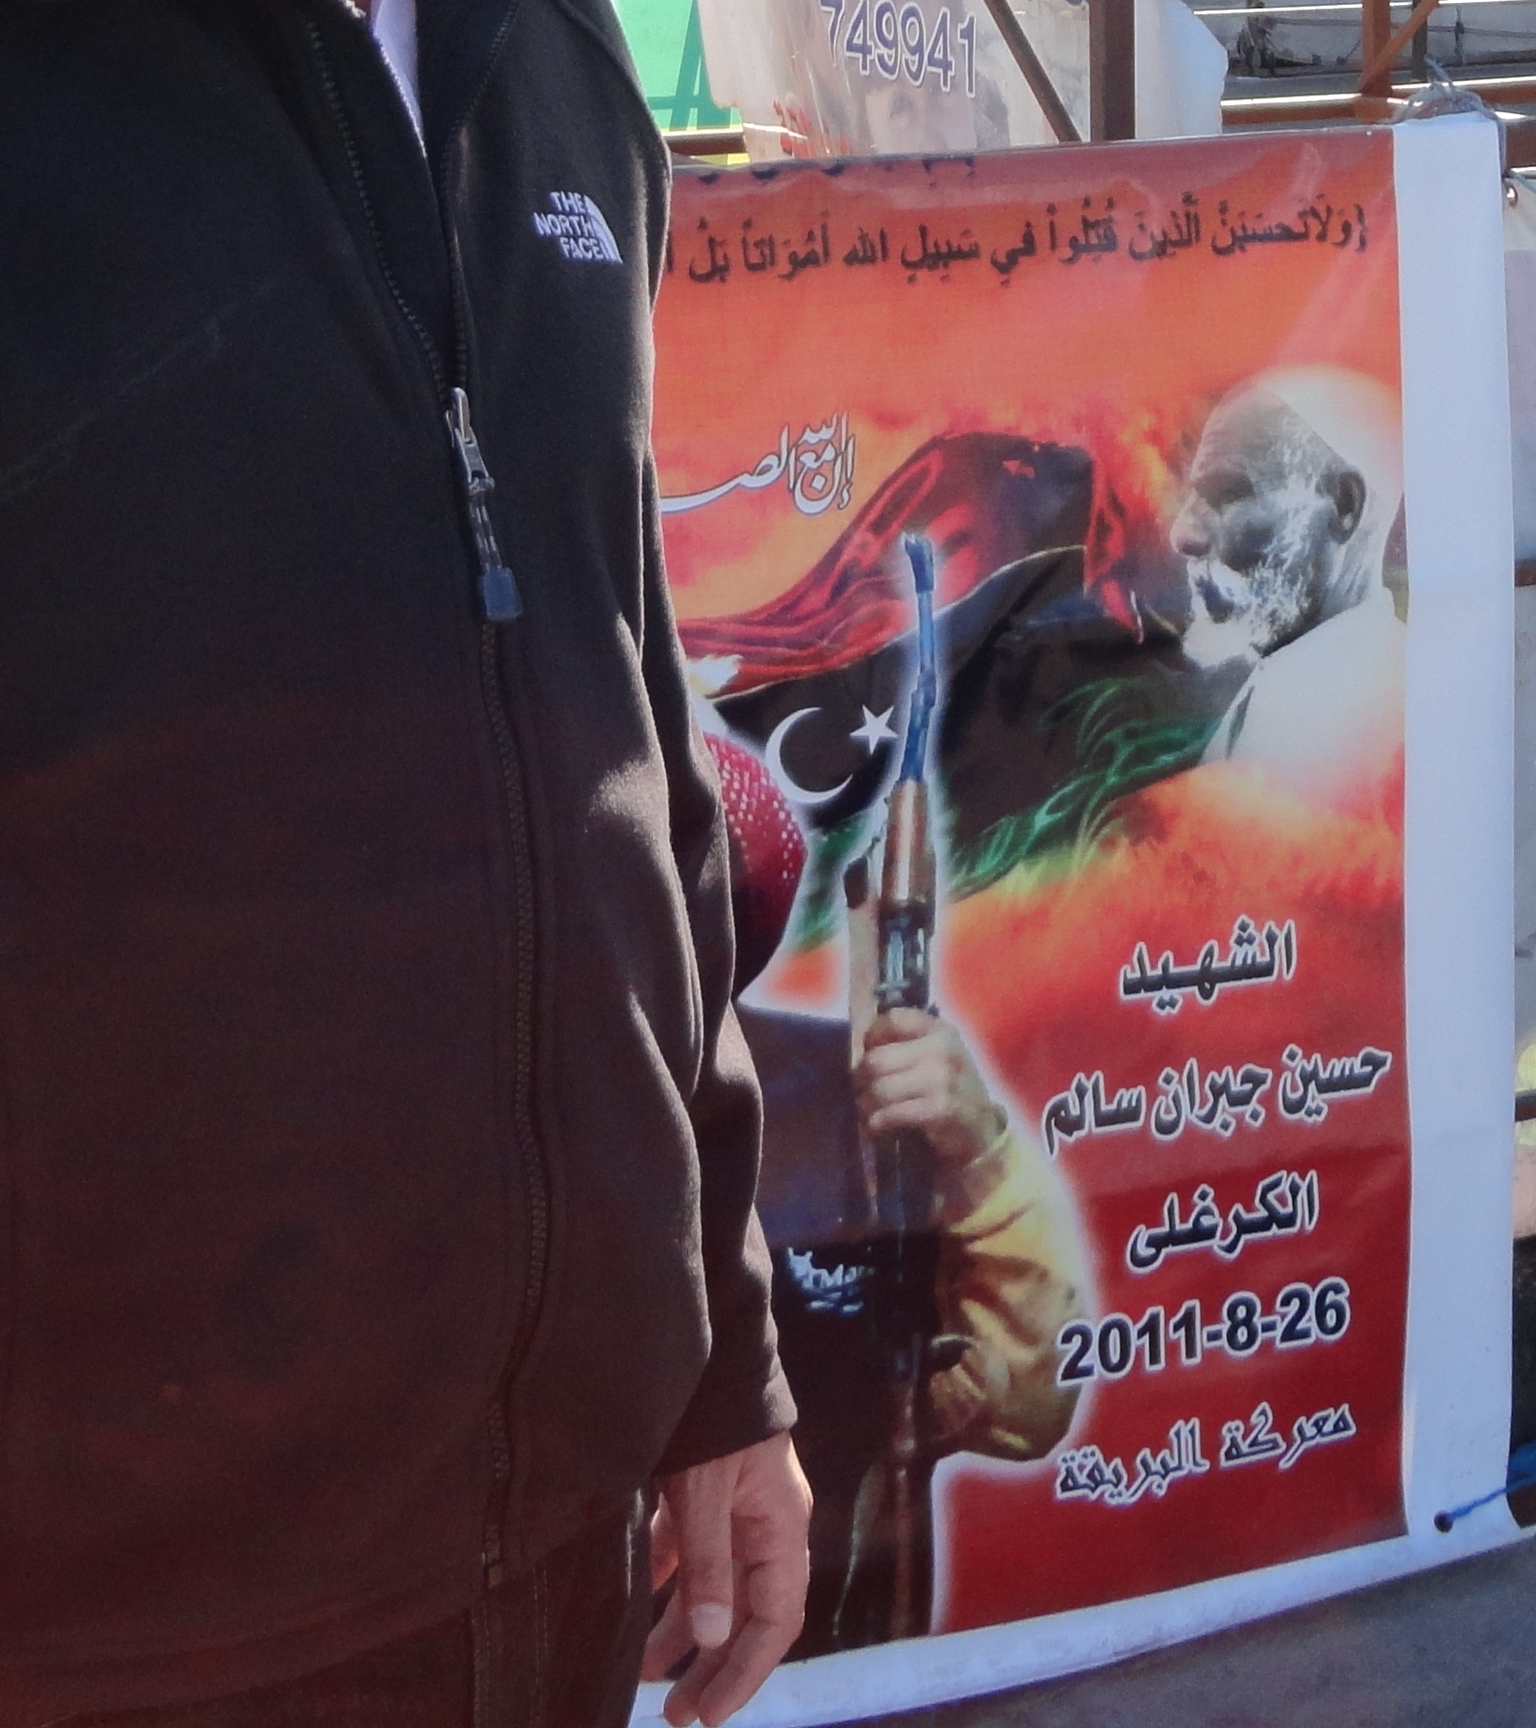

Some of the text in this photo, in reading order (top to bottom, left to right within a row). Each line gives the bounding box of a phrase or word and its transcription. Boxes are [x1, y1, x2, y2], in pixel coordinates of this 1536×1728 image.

[533, 212, 595, 236] NORTH
[550, 191, 584, 213] THE
[560, 237, 605, 259] FACE
[1120, 915, 1296, 1014] الشهيد
[1042, 1044, 1392, 1155] حسين جبران سالم
[1057, 1276, 1351, 1386] 2011-8-26
[1056, 1402, 1356, 1503] معركة البريقة
